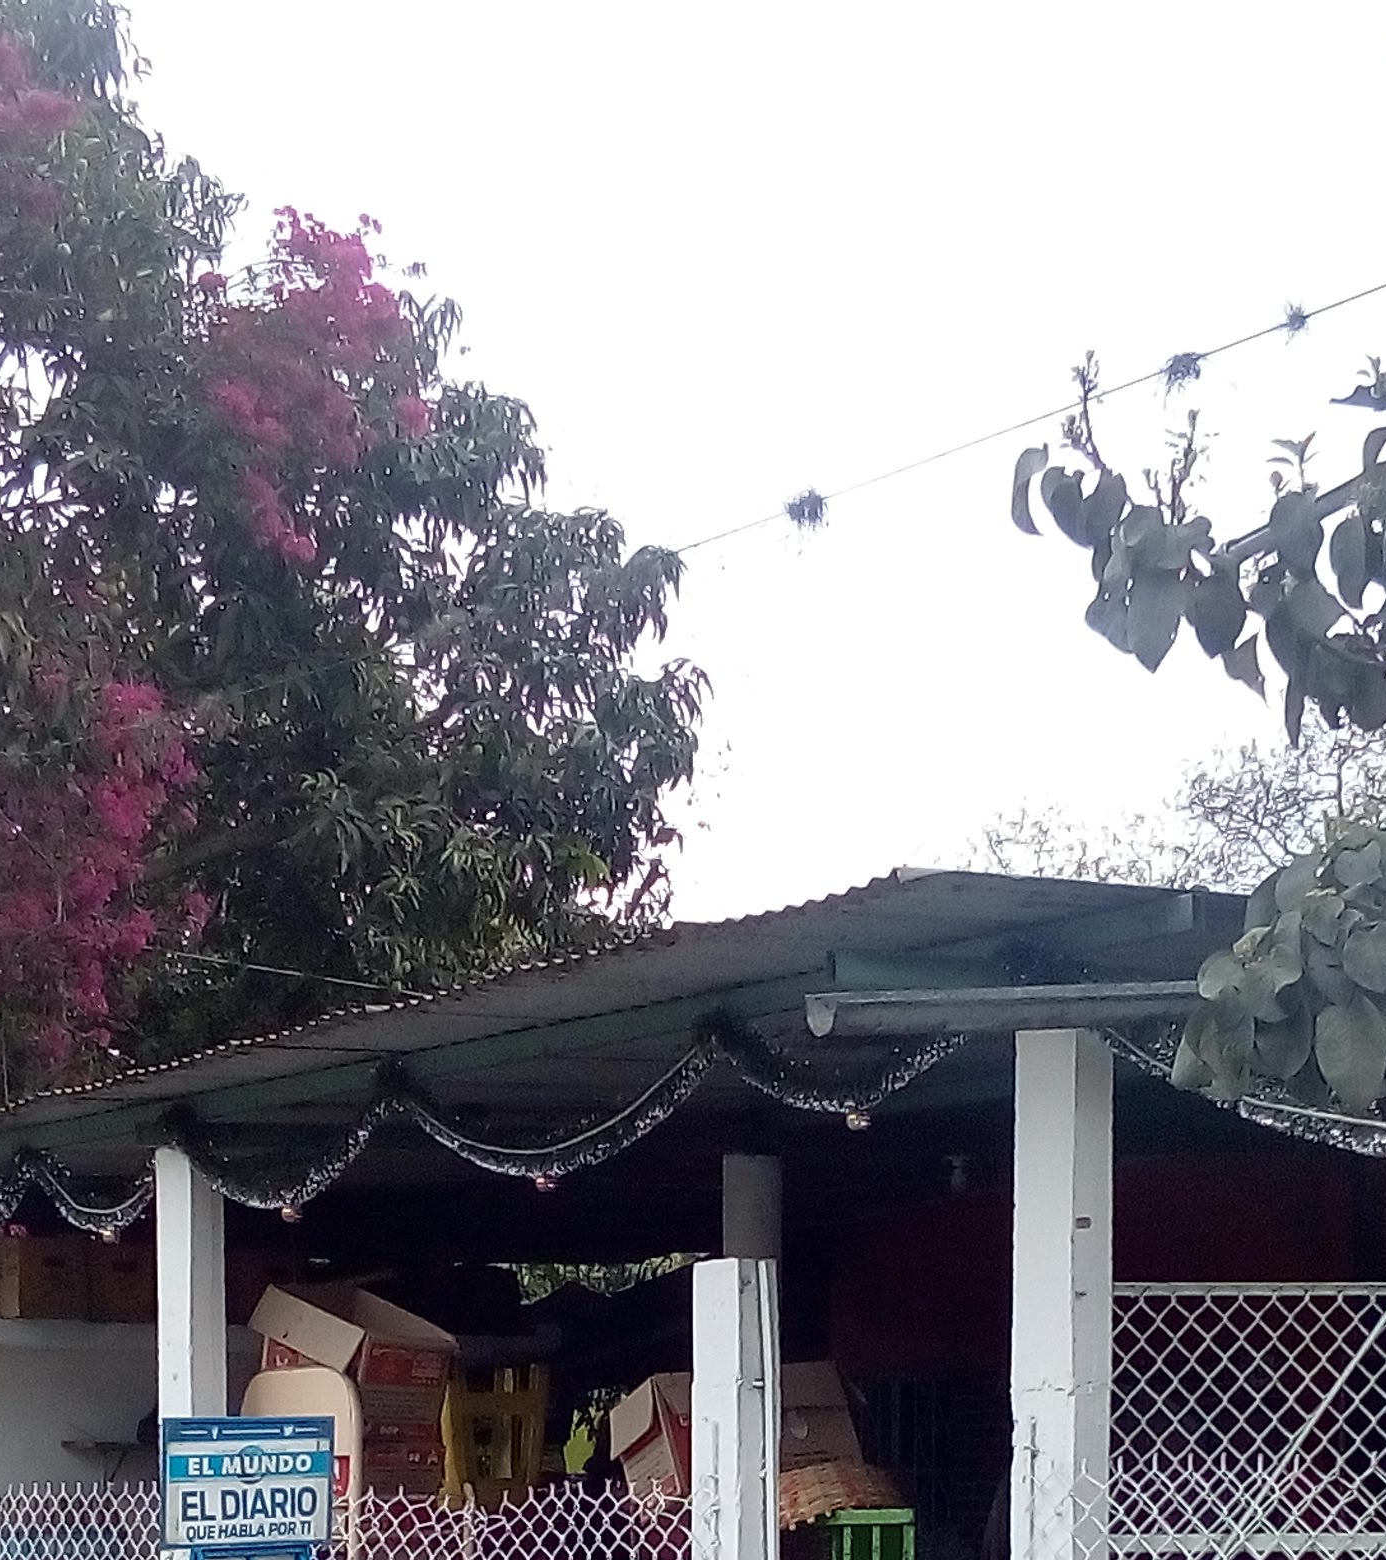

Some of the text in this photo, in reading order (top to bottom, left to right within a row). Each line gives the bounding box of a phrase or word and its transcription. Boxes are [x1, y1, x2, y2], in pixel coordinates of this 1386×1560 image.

[187, 1454, 313, 1476] EL MUNDO
[180, 1486, 318, 1523] EL DIARIO
[186, 1519, 312, 1543] QUE HABLA POR TI
